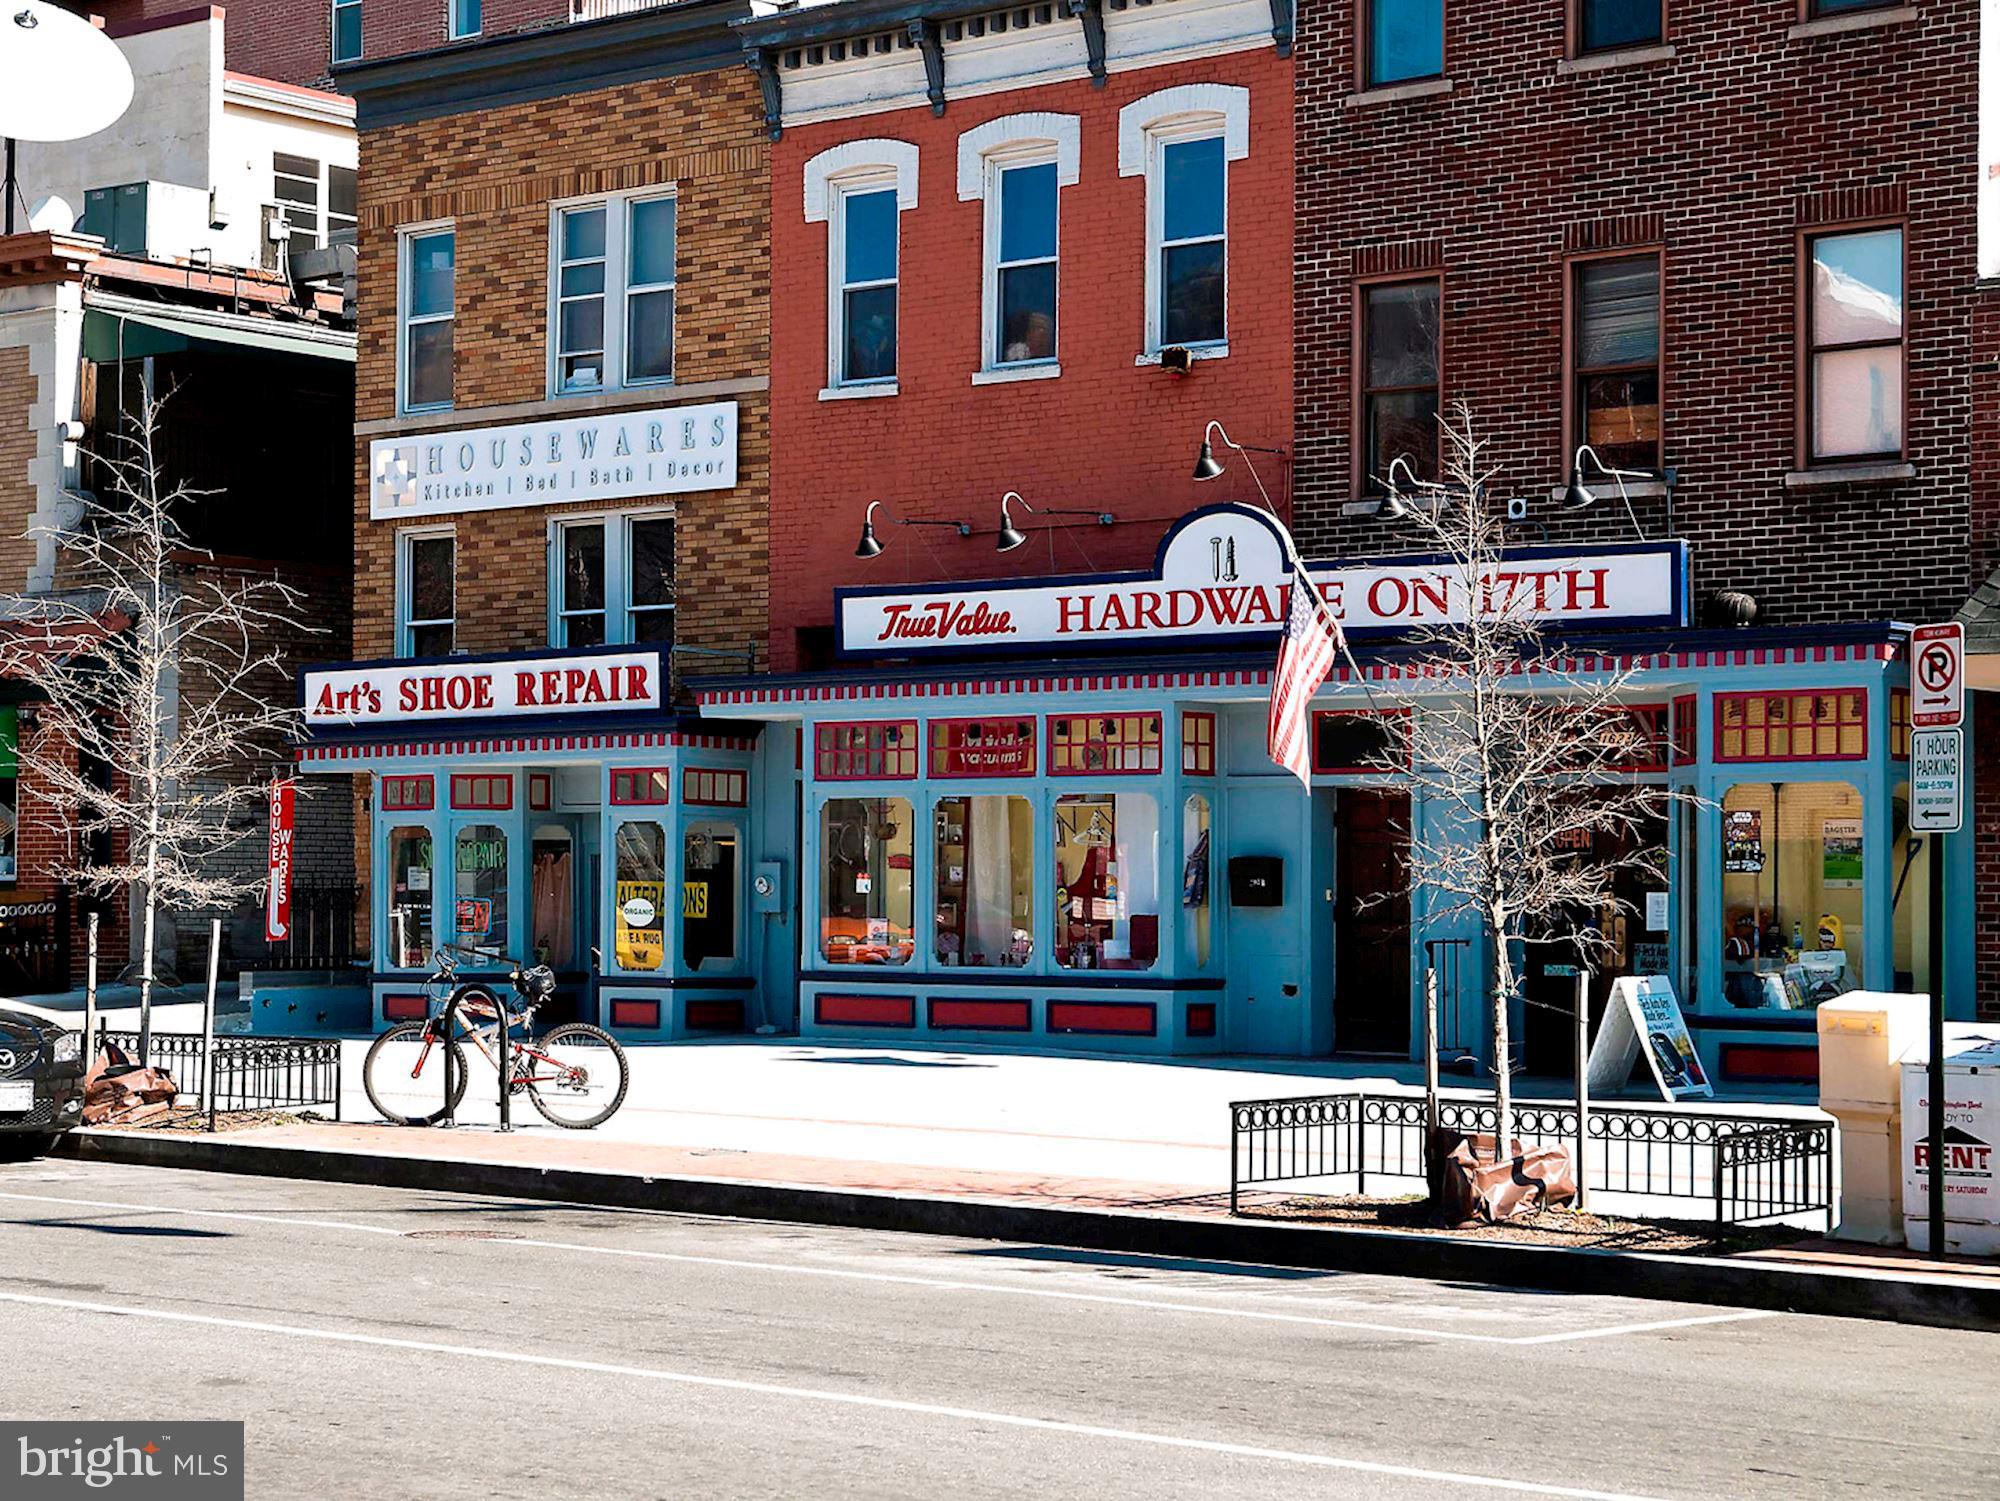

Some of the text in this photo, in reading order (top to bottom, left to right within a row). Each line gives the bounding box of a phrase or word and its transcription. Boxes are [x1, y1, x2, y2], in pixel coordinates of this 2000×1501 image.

[425, 415, 725, 476] HOUSEWARES
[424, 460, 724, 501] Kitchen Bed Bath Decor
[1367, 576, 1451, 617] ON
[1479, 569, 1610, 613] 17TH
[312, 665, 651, 715] Art's SHOE REPAIR
[1916, 737, 1956, 755] 1 HOUR
[1916, 758, 1956, 777] PARKING
[271, 787, 283, 862] HOUSE
[277, 829, 292, 905] WARES
[623, 907, 653, 916] ORGANIC
[1960, 1114, 1974, 1123] TO
[1914, 1145, 1992, 1170] RENT
[1956, 1185, 1988, 1195] SATURDAY
